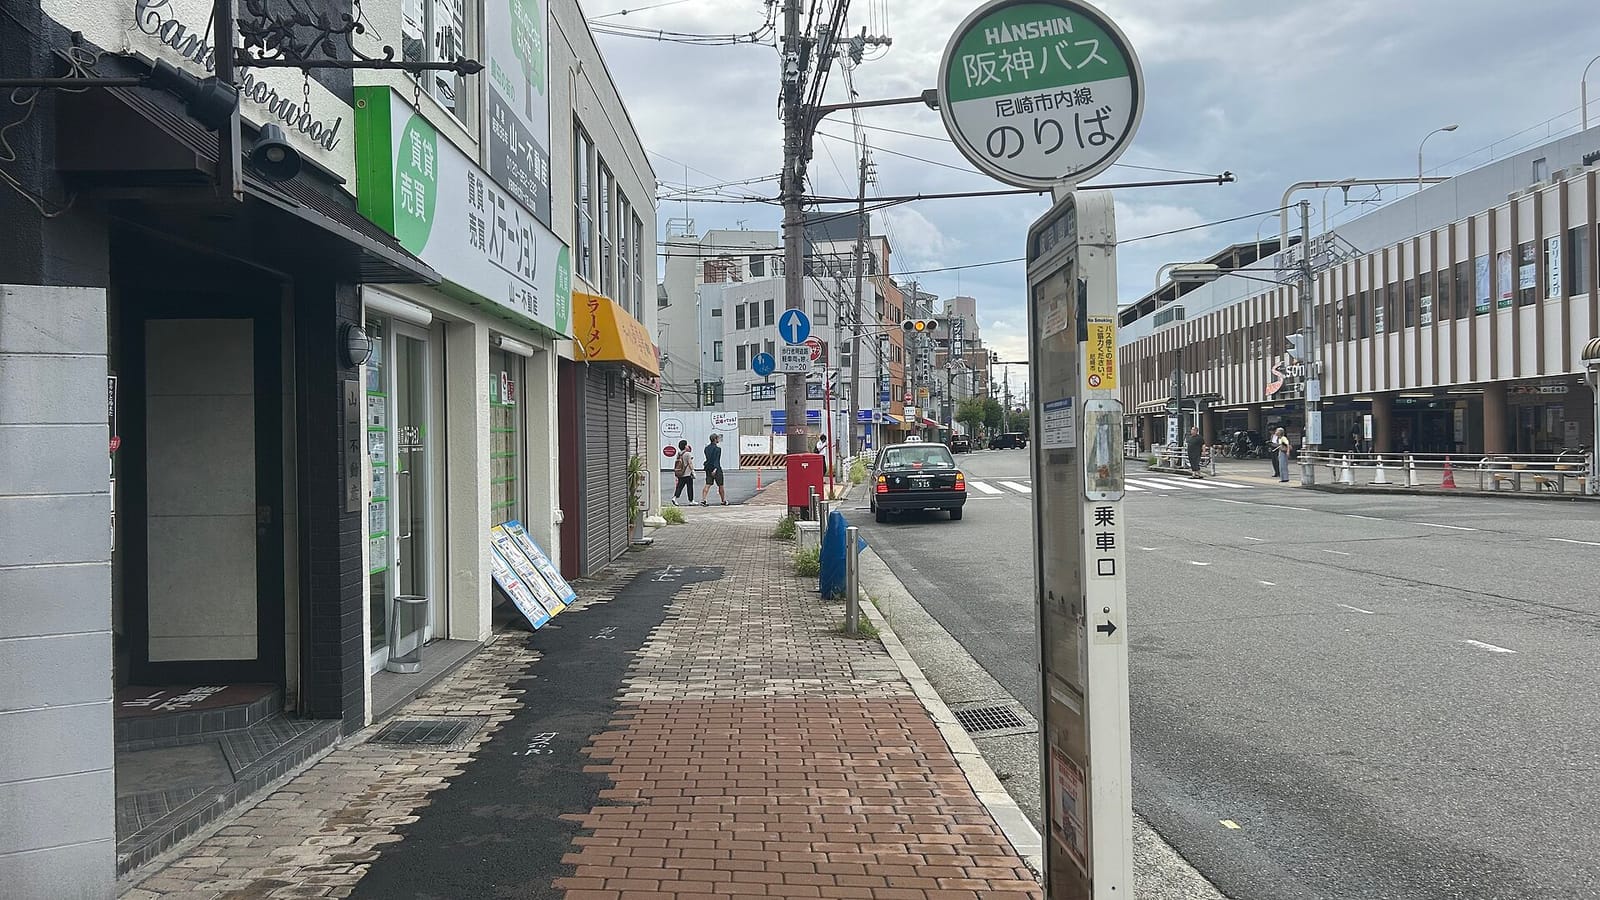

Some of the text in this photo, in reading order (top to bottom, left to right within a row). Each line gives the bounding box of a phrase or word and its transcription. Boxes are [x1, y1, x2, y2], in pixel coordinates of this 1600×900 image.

[984, 16, 1074, 45] HANSHIN
[962, 38, 1108, 88] 阪神バス
[995, 86, 1094, 118] 尼崎市内線
[409, 127, 435, 182] 賃貸
[509, 122, 548, 190] 山一不動産
[986, 105, 1115, 159] のりば
[400, 171, 426, 223] 売買
[467, 169, 485, 214] 賃貸
[469, 211, 486, 254] 売買
[487, 188, 537, 281] ステーション
[587, 299, 602, 358] ラーメン
[1094, 506, 1116, 577] 乗車口
